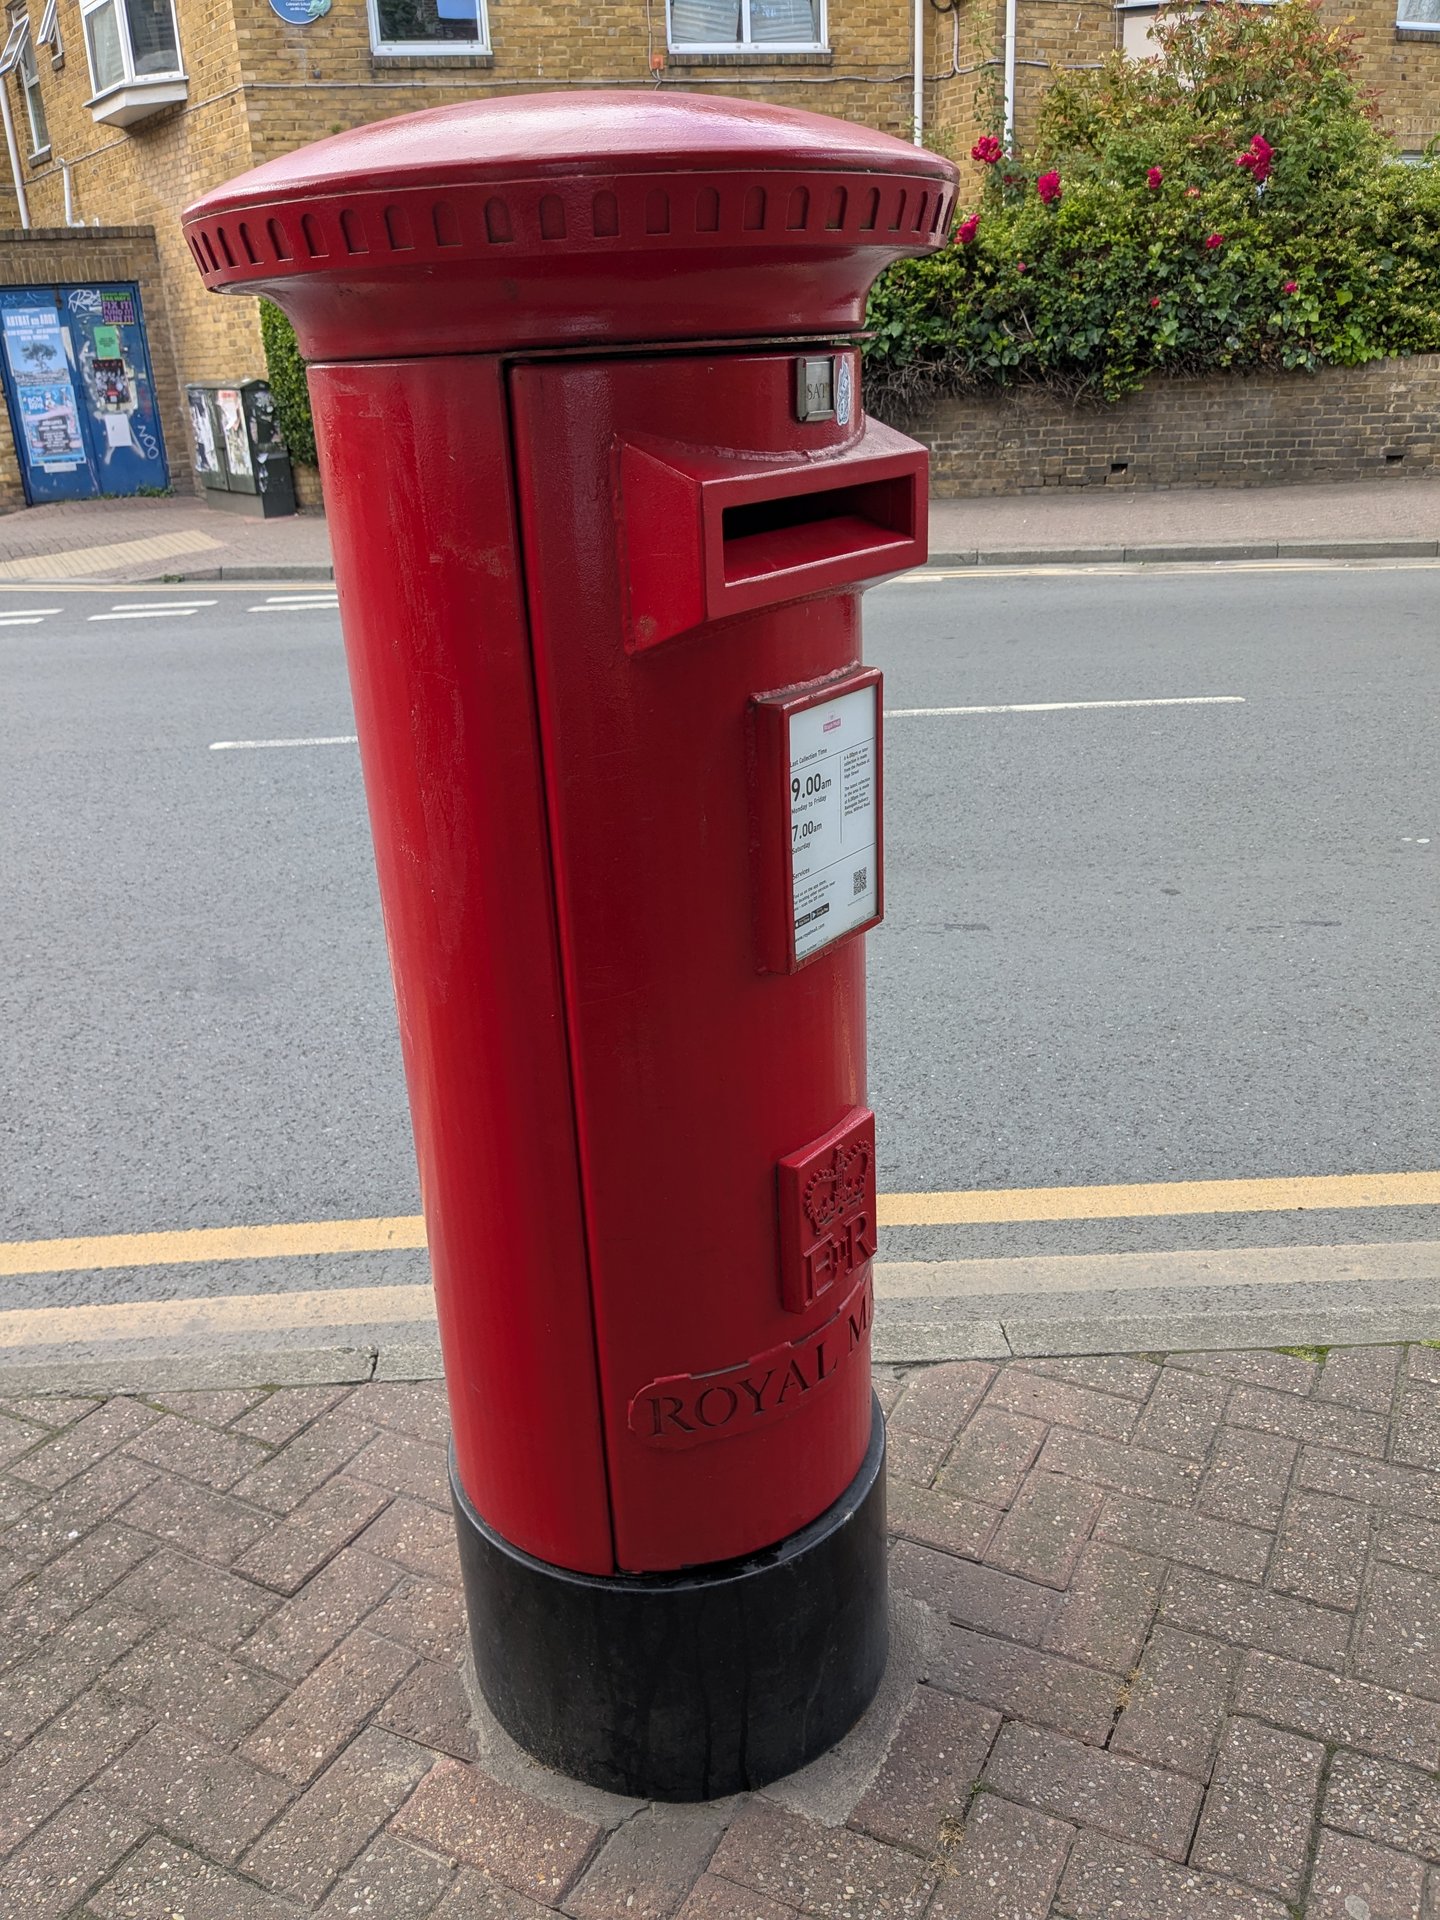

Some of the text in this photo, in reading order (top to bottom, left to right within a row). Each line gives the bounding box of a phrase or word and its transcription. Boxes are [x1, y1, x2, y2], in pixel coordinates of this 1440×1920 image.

[807, 382, 828, 400] SAT
[799, 752, 818, 764] Collection
[792, 773, 831, 802] 9.00am
[792, 804, 807, 814] Monday
[814, 795, 827, 805] Friday
[792, 821, 822, 842] 7.00am
[792, 842, 811, 854] Saturday
[792, 868, 810, 880] Services
[647, 1343, 838, 1436] ROYAL
